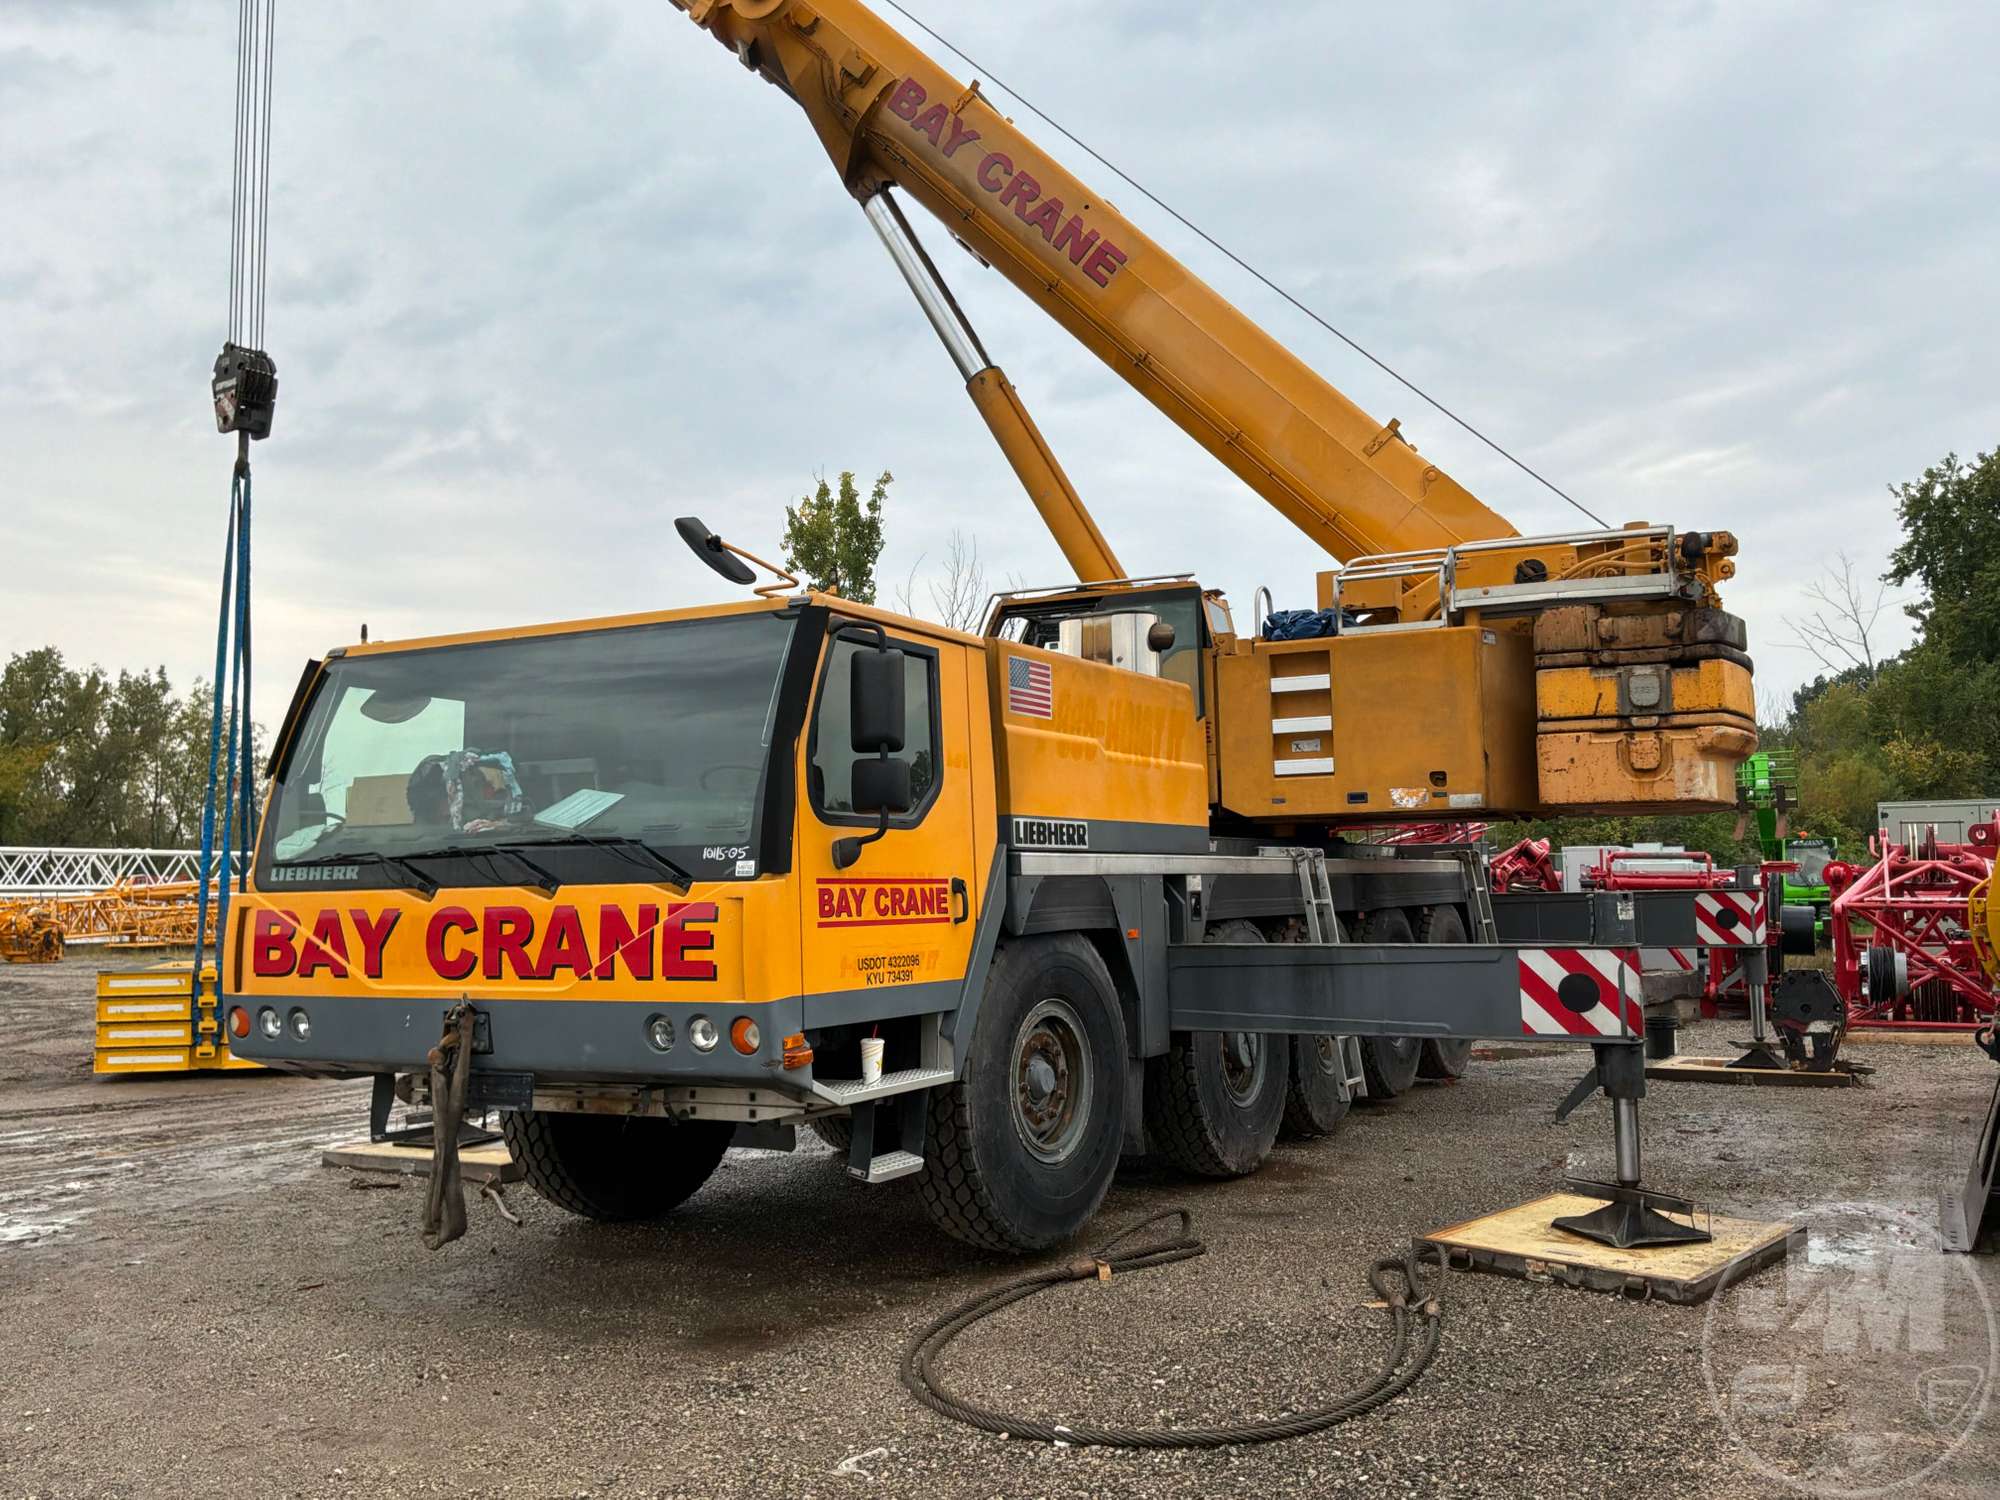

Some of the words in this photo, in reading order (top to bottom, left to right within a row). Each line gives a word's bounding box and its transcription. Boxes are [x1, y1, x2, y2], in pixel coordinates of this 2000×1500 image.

[887, 77, 981, 158] BAY
[977, 152, 1128, 288] CRANE
[1014, 820, 1087, 846] LIEBHERR
[270, 865, 360, 881] LIEBHERR
[817, 887, 866, 918] BAY
[874, 887, 949, 917] CRANE
[253, 908, 403, 979] BAY
[425, 902, 719, 982] CRANE
[857, 956, 887, 971] USDOT
[888, 954, 920, 968] 4322096
[866, 972, 885, 985] KYU
[887, 969, 913, 983] 734391
